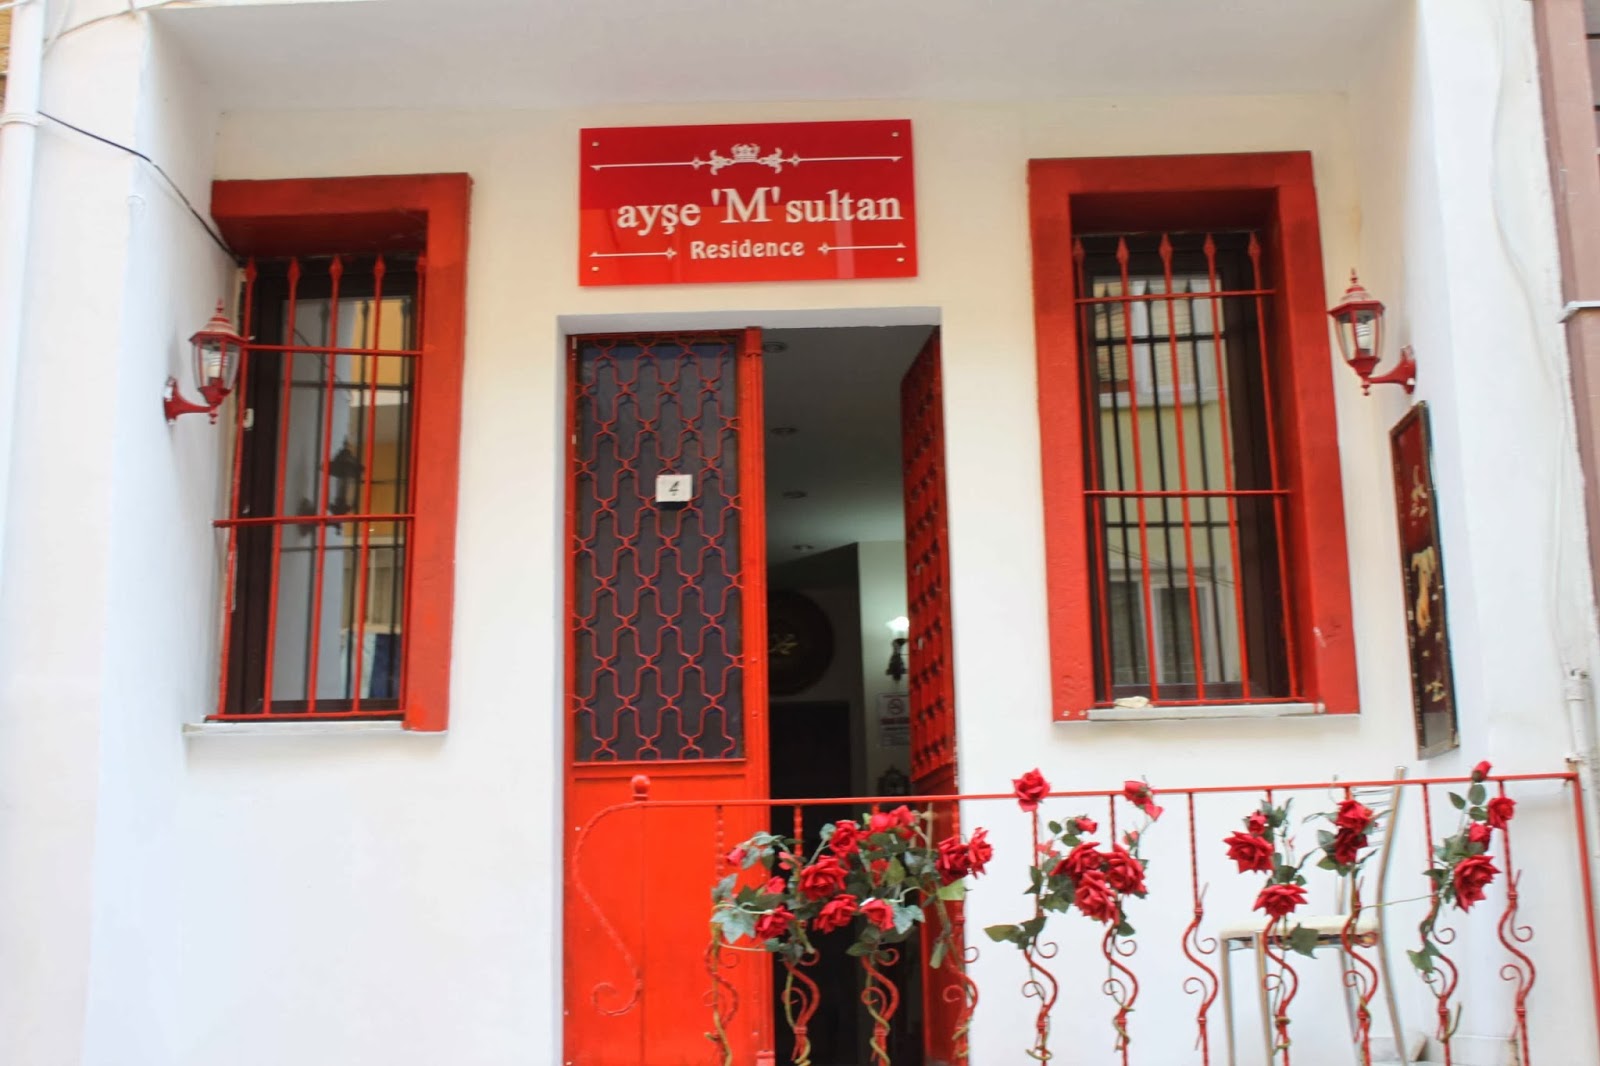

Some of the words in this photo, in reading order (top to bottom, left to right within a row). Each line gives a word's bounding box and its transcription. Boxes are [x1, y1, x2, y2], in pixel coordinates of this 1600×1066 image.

[617, 203, 701, 236] ayşe
[785, 189, 904, 223] sultan
[690, 239, 805, 260] Residence
[668, 480, 681, 497] 4
